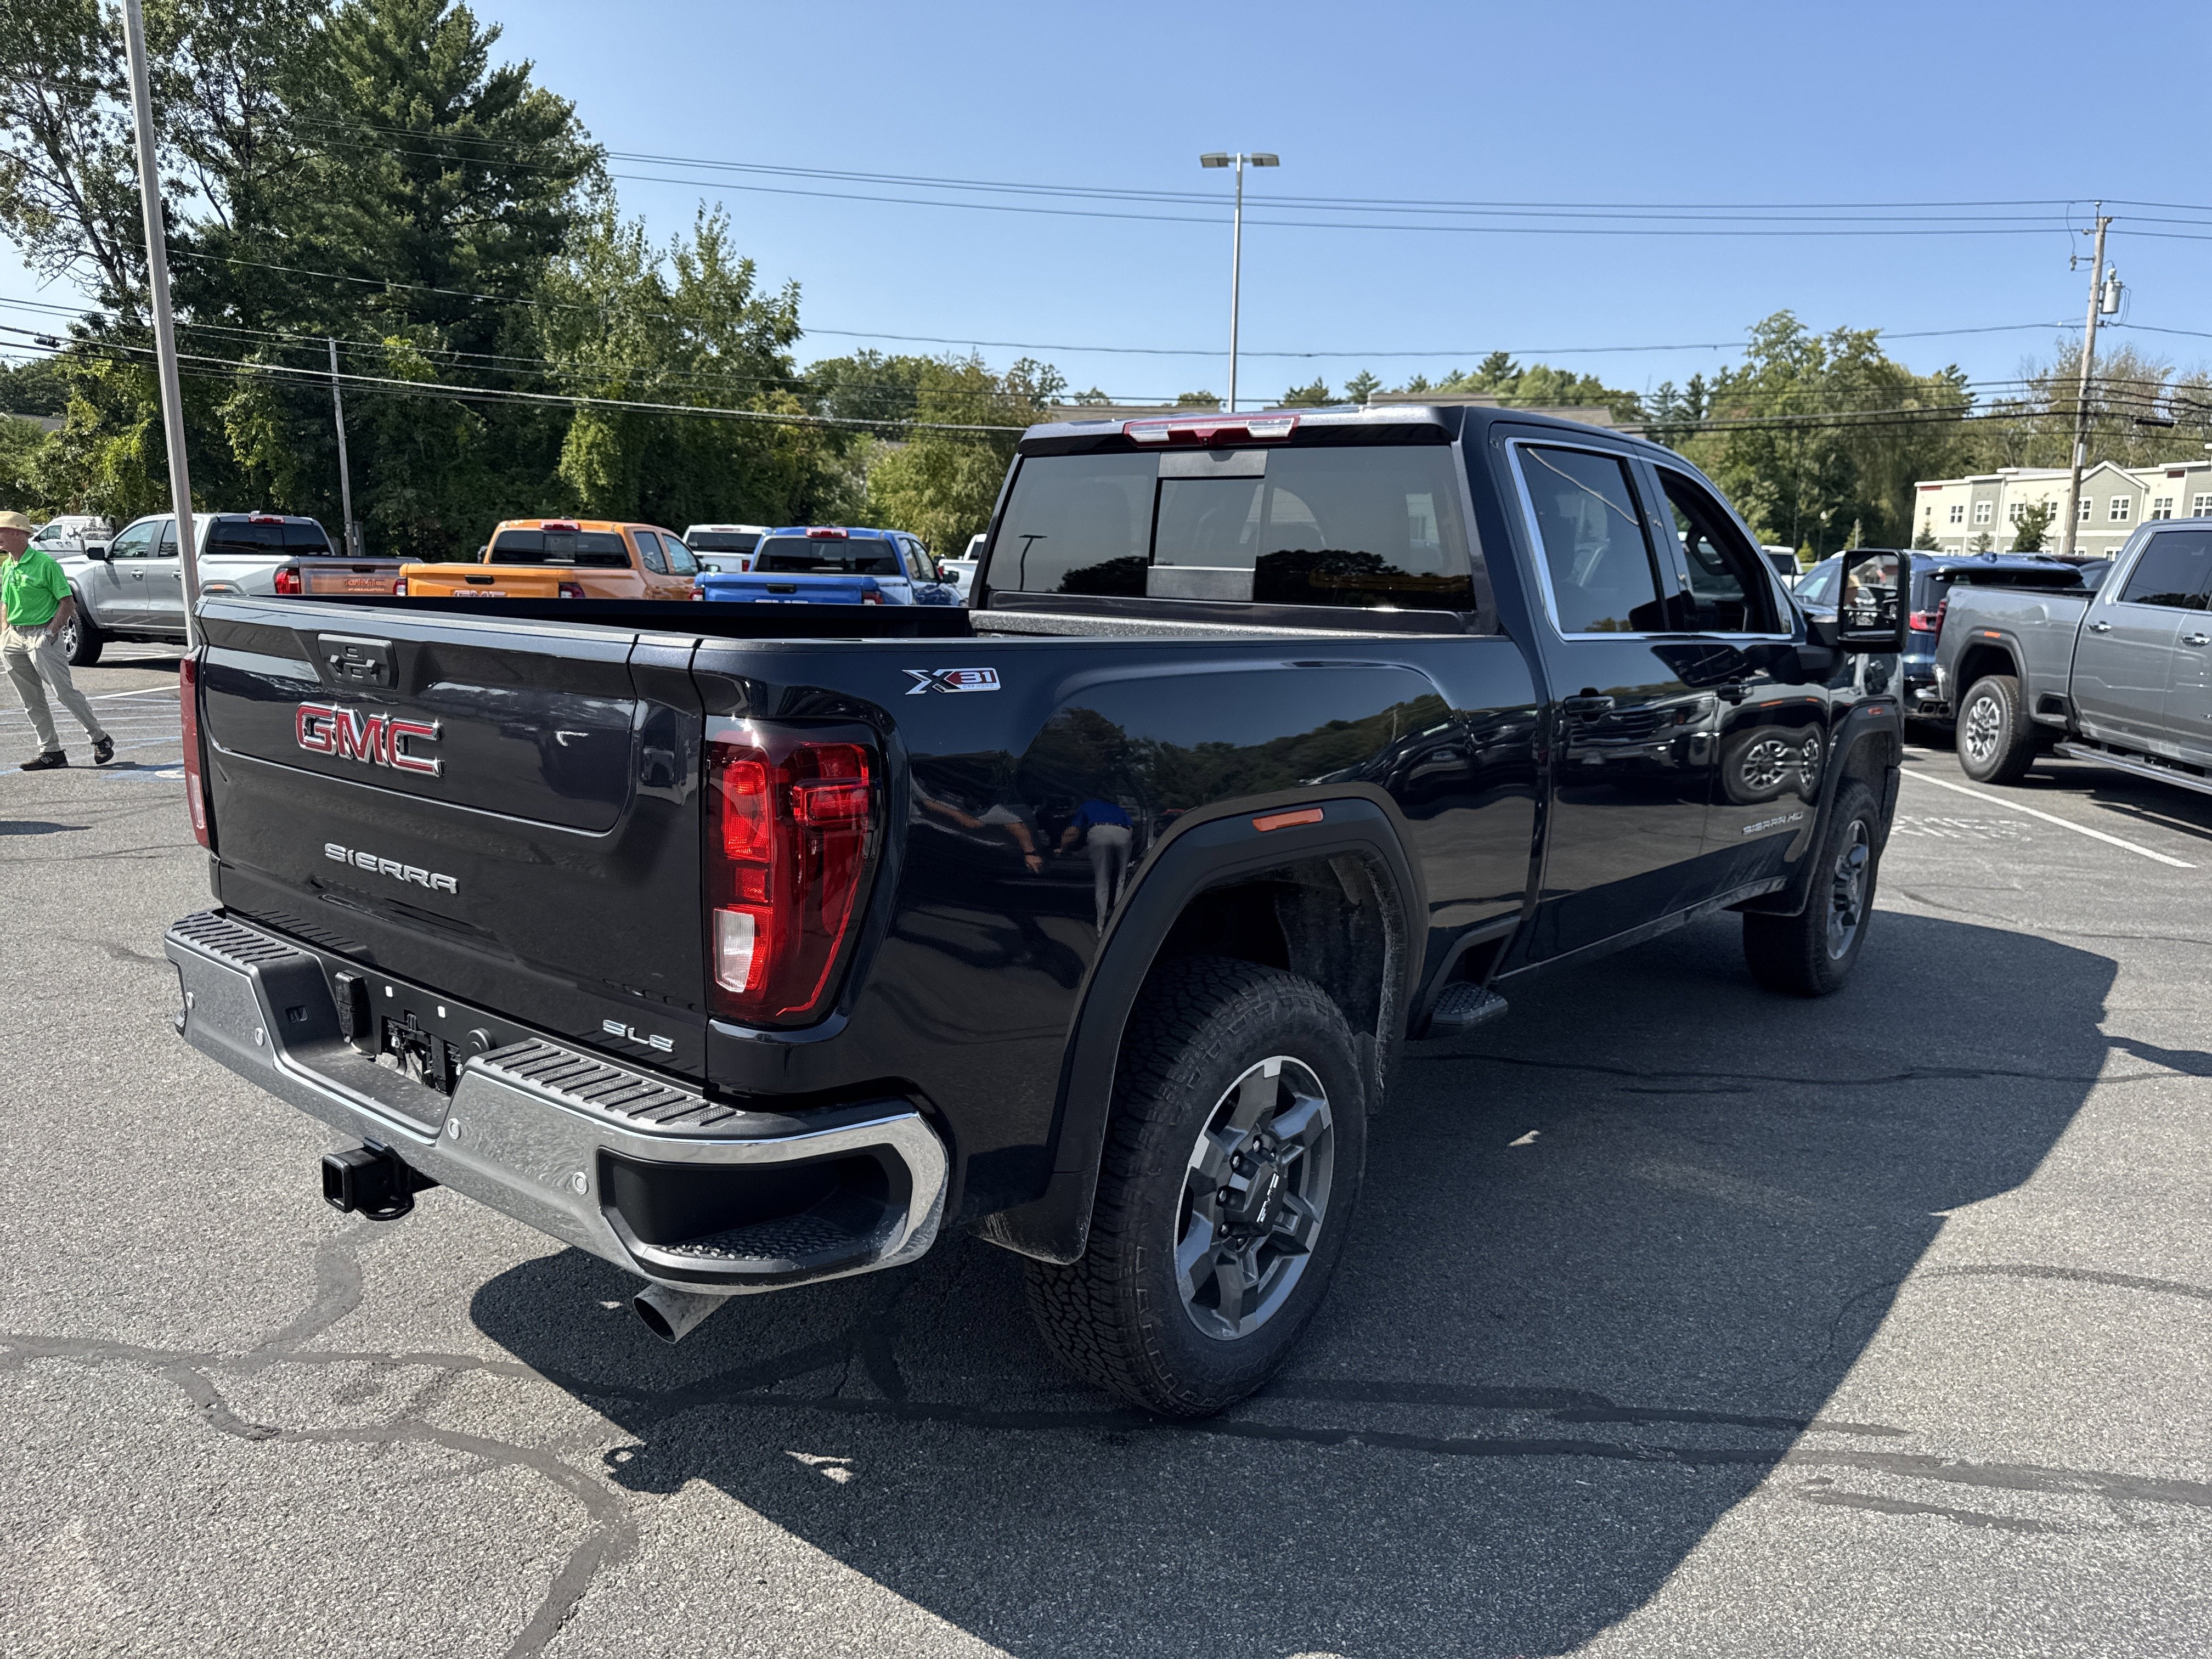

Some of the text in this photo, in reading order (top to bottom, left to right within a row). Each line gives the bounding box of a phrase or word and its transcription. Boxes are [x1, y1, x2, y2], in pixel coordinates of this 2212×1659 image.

[296, 701, 443, 778] GMC
[1742, 816, 1786, 836] SIERRA
[325, 843, 459, 894] SIERRA
[603, 1019, 674, 1052] SLE
